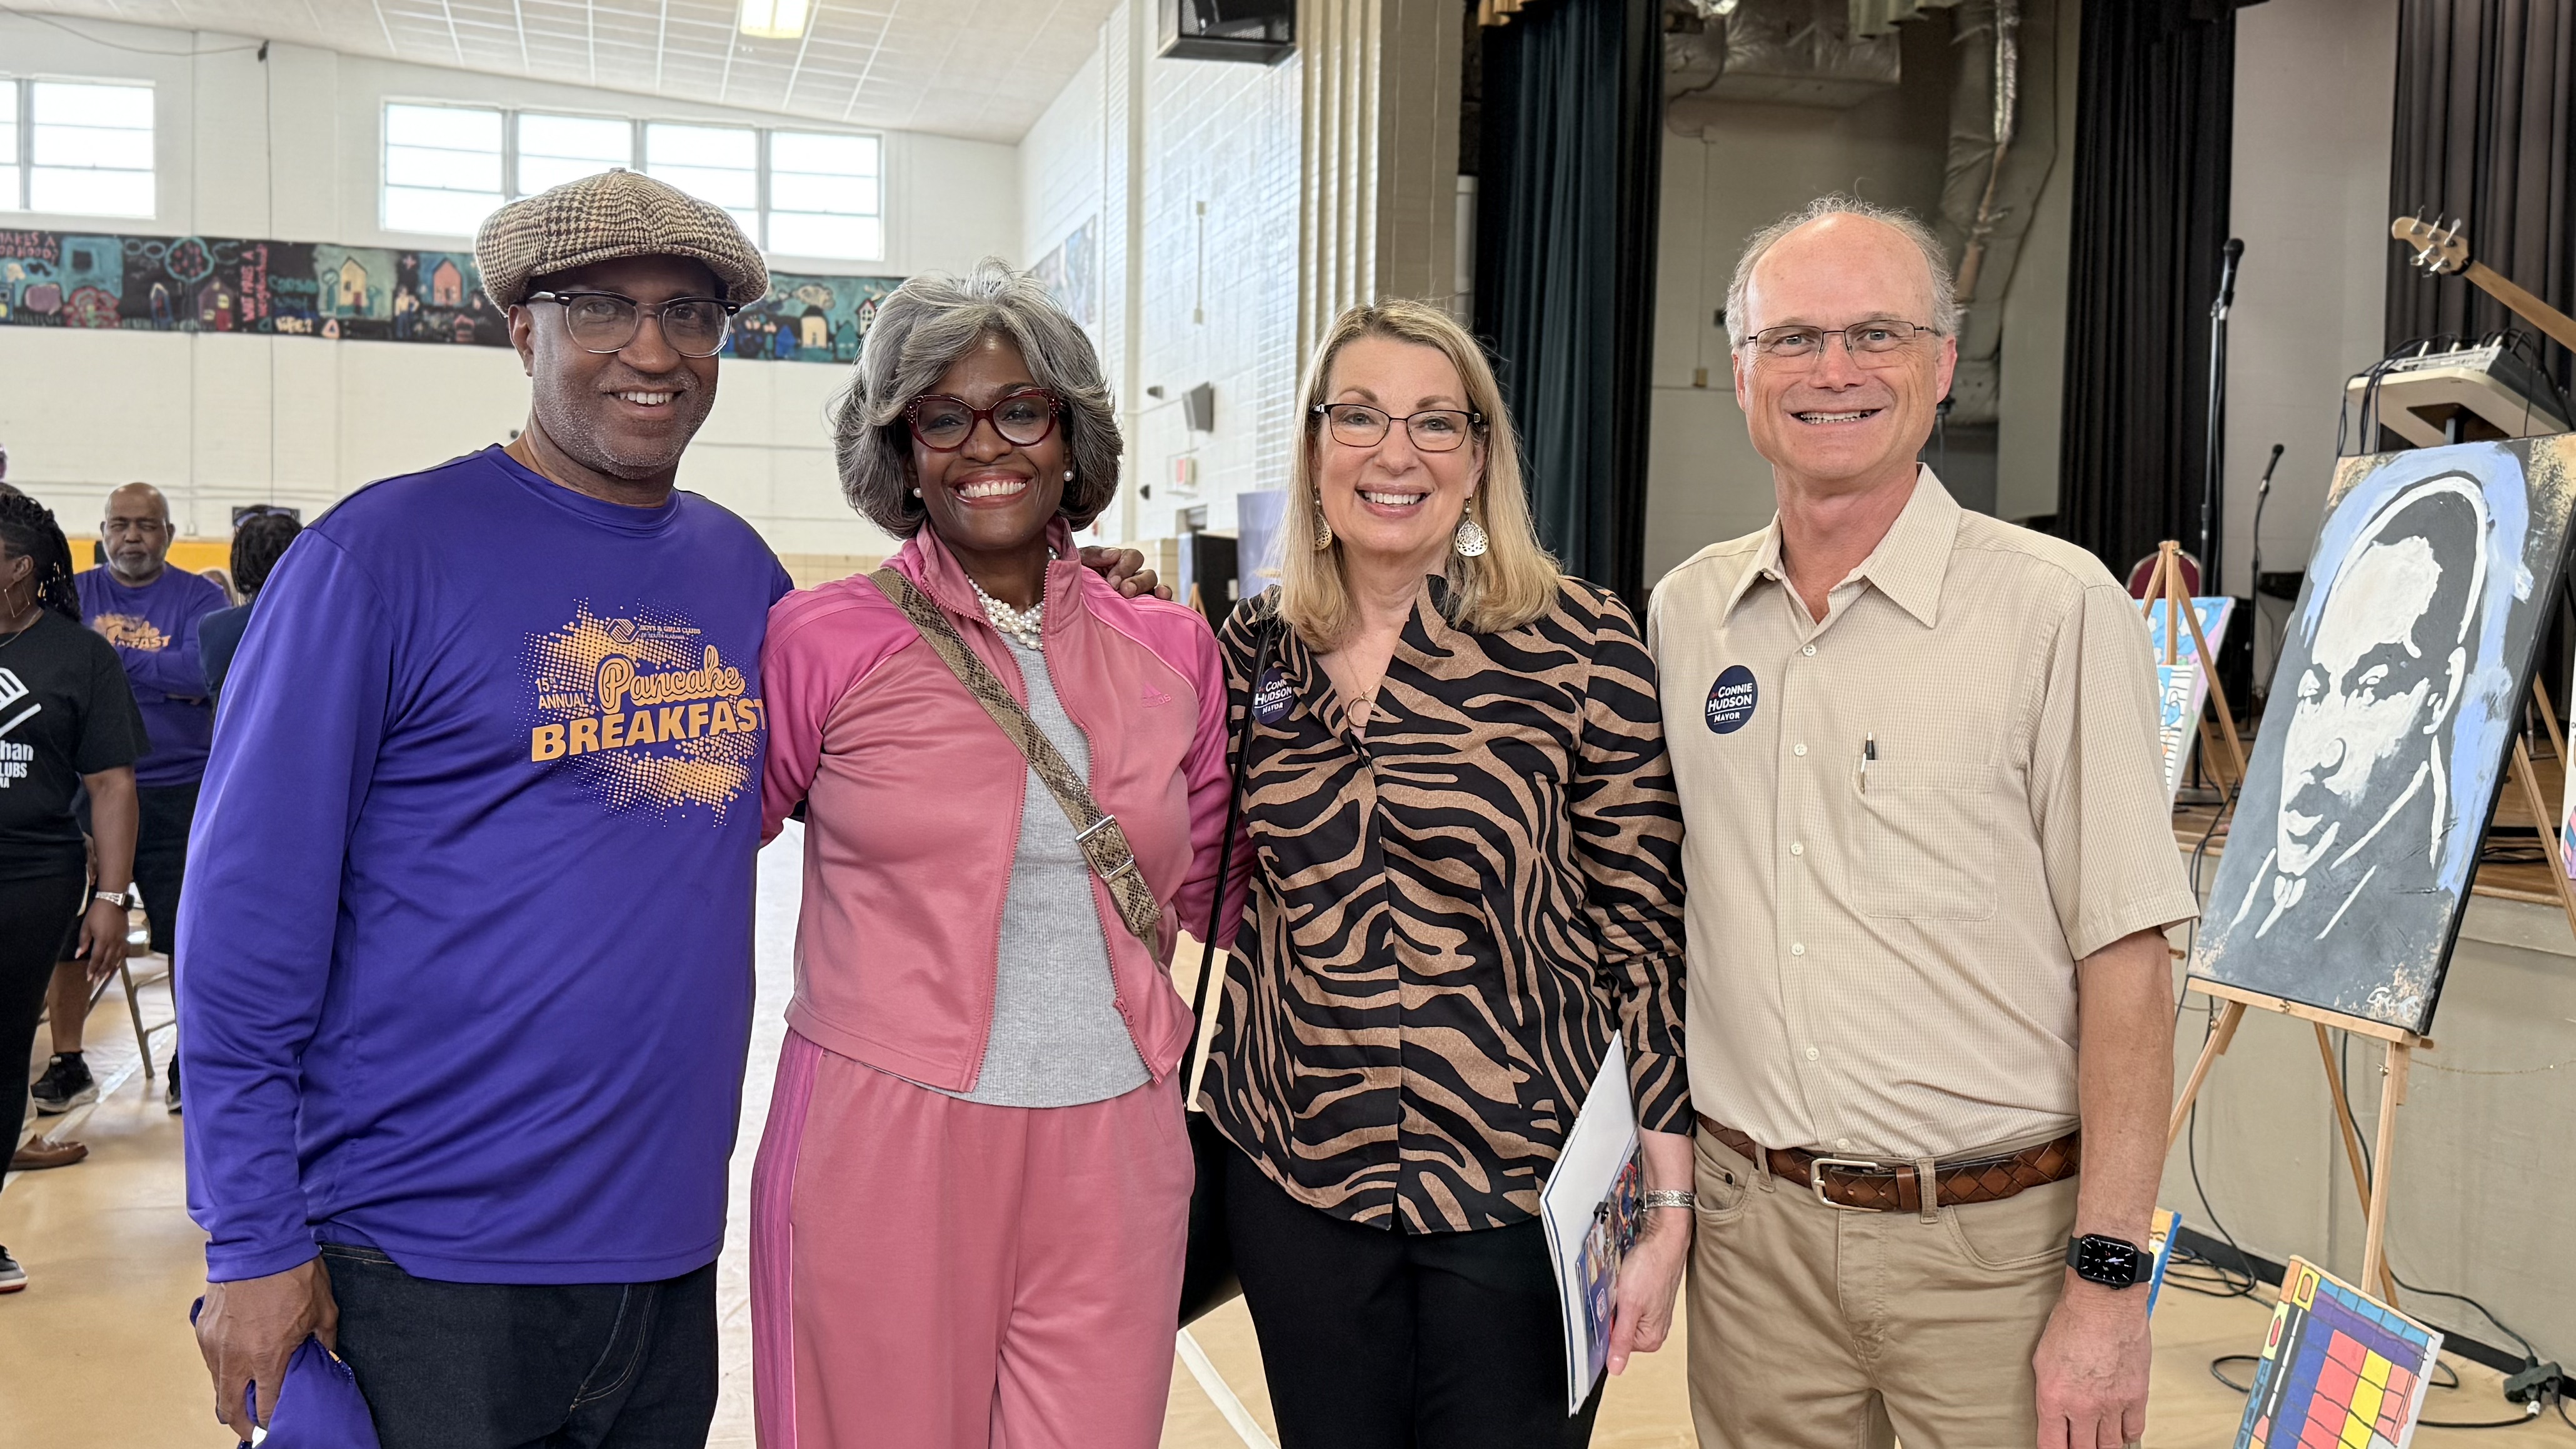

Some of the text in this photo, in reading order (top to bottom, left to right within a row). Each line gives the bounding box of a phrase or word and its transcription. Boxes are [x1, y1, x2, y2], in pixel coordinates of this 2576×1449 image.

[598, 644, 745, 714] Pancake
[1255, 686, 1292, 706] HUDSON
[1718, 683, 1753, 698] CONNIE
[538, 692, 589, 709] ANNUAL
[1262, 702, 1284, 714] MAYOR
[1707, 694, 1752, 713] HUDSON
[1713, 711, 1740, 723] MAYOR
[531, 698, 766, 762] BREAKFAST
[0, 740, 34, 761] han
[0, 761, 28, 778] LUBS
